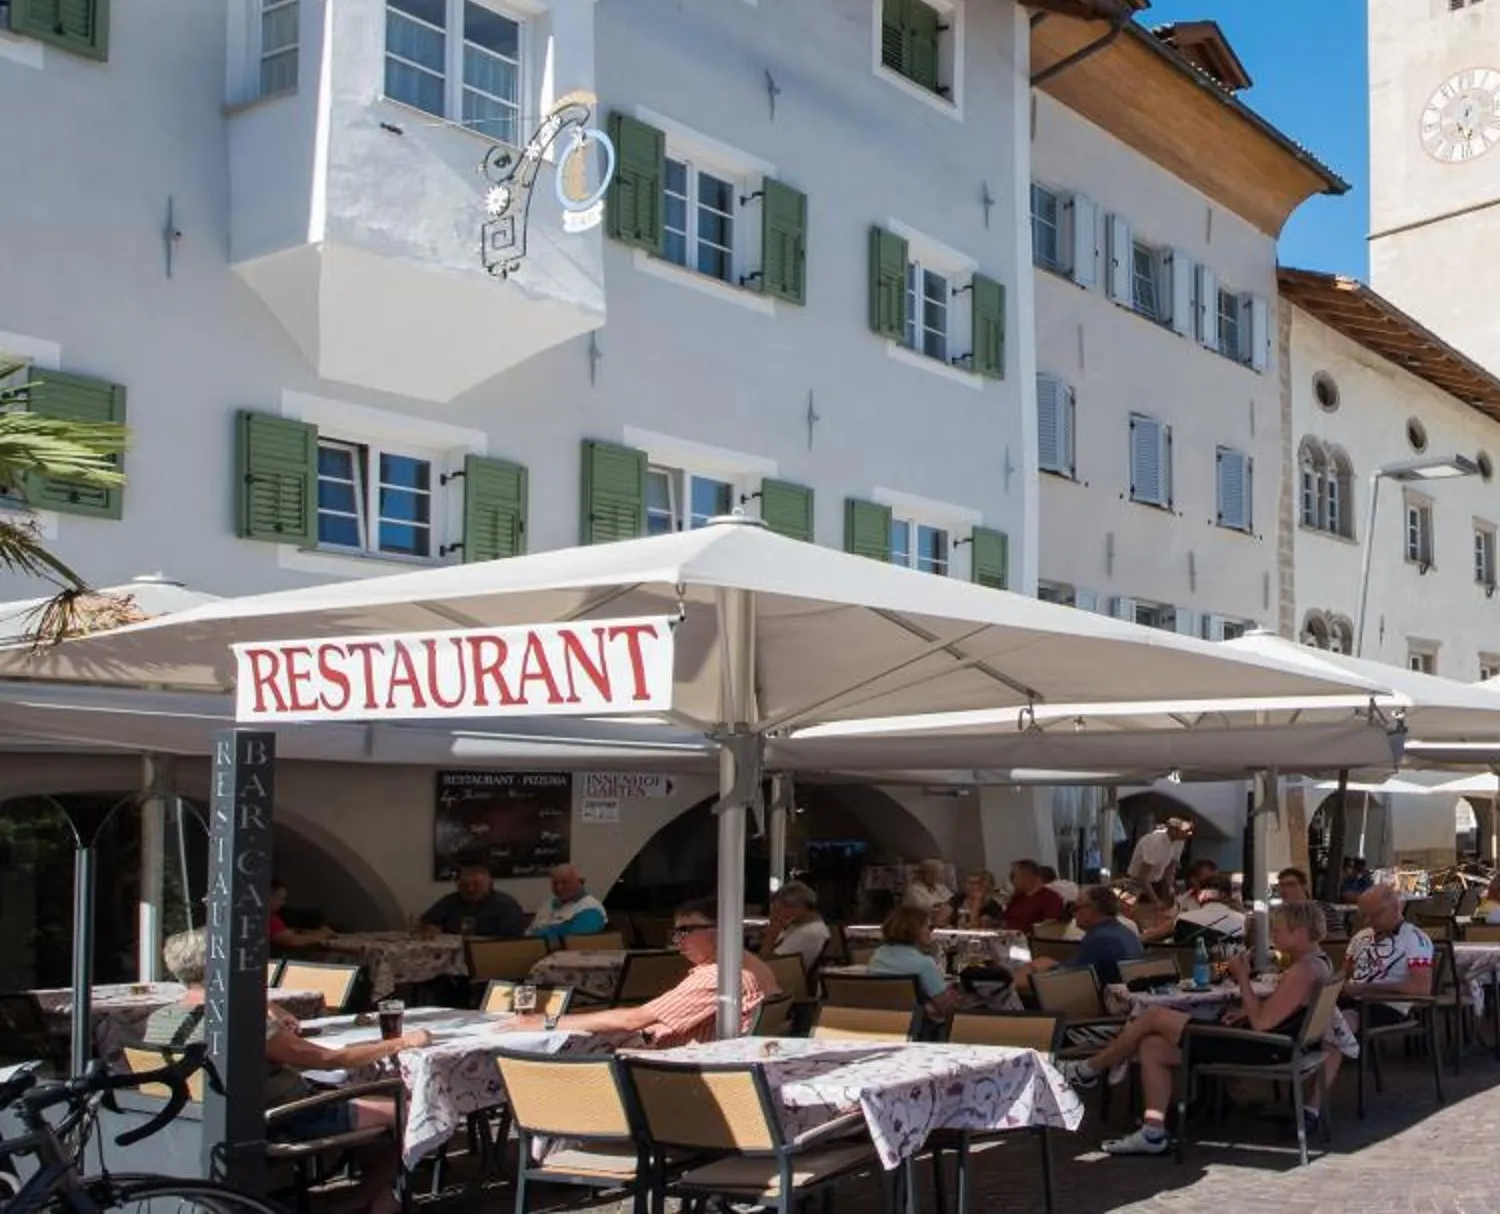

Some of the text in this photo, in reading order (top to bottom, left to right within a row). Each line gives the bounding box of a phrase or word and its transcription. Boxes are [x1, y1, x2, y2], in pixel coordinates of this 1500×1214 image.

[245, 625, 660, 712] RESTAURANT
[443, 774, 514, 786] RESTAURANT
[208, 741, 232, 1055] RESTAURANT
